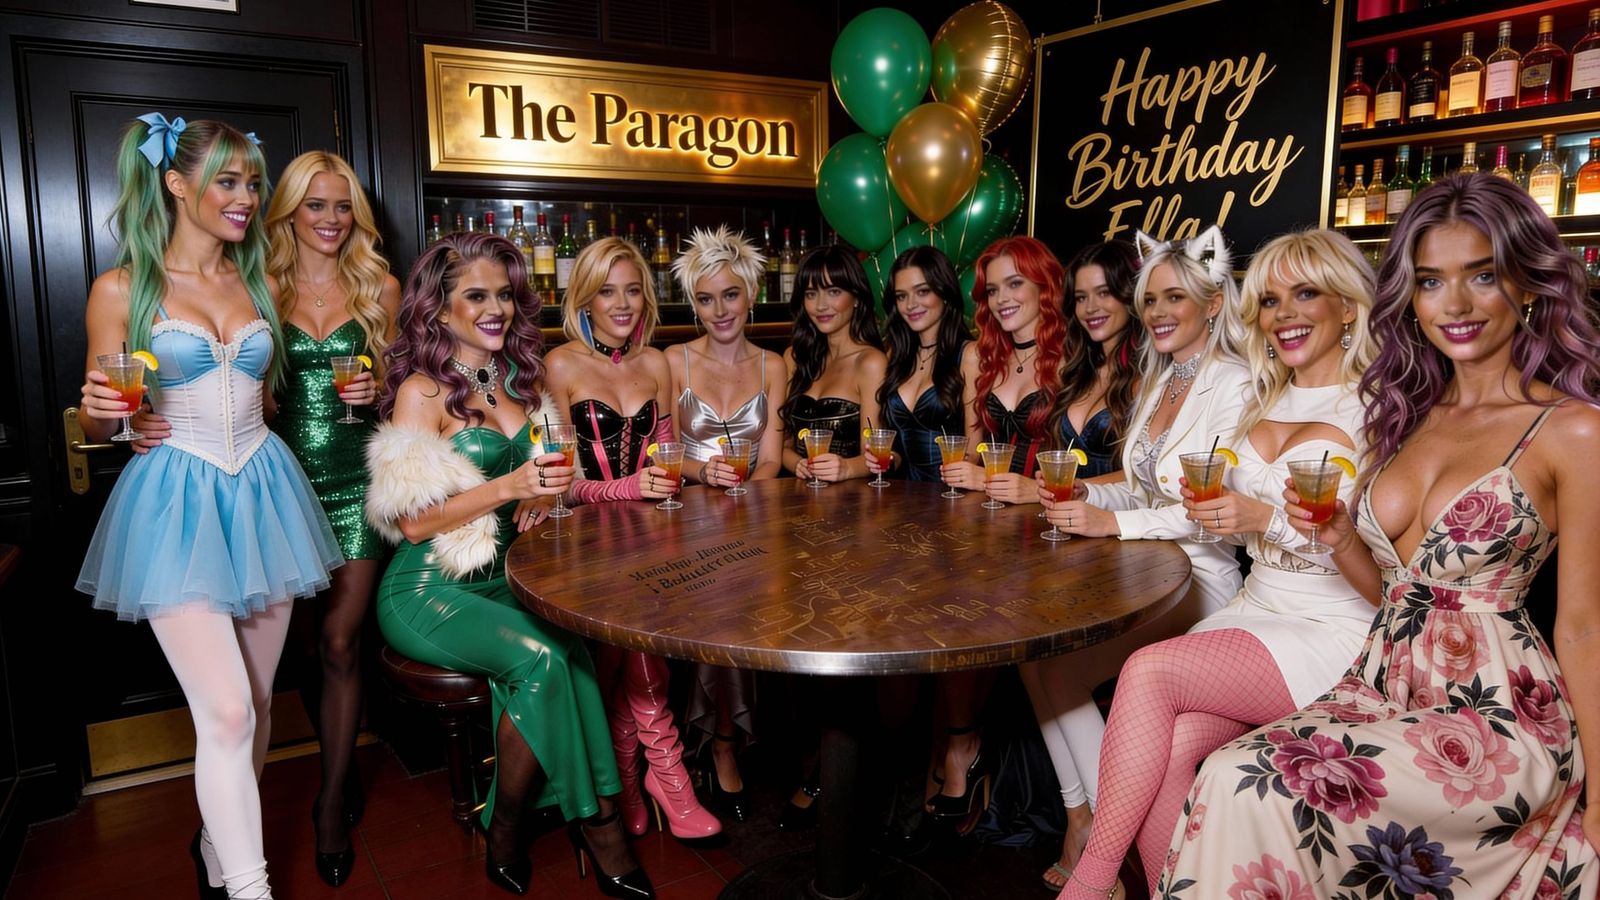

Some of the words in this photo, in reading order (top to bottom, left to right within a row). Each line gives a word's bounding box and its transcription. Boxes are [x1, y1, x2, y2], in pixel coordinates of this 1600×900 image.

[468, 82, 576, 143] The
[592, 92, 799, 169] Paragon
[1100, 47, 1277, 130] Happy
[1065, 120, 1304, 209] Birthday
